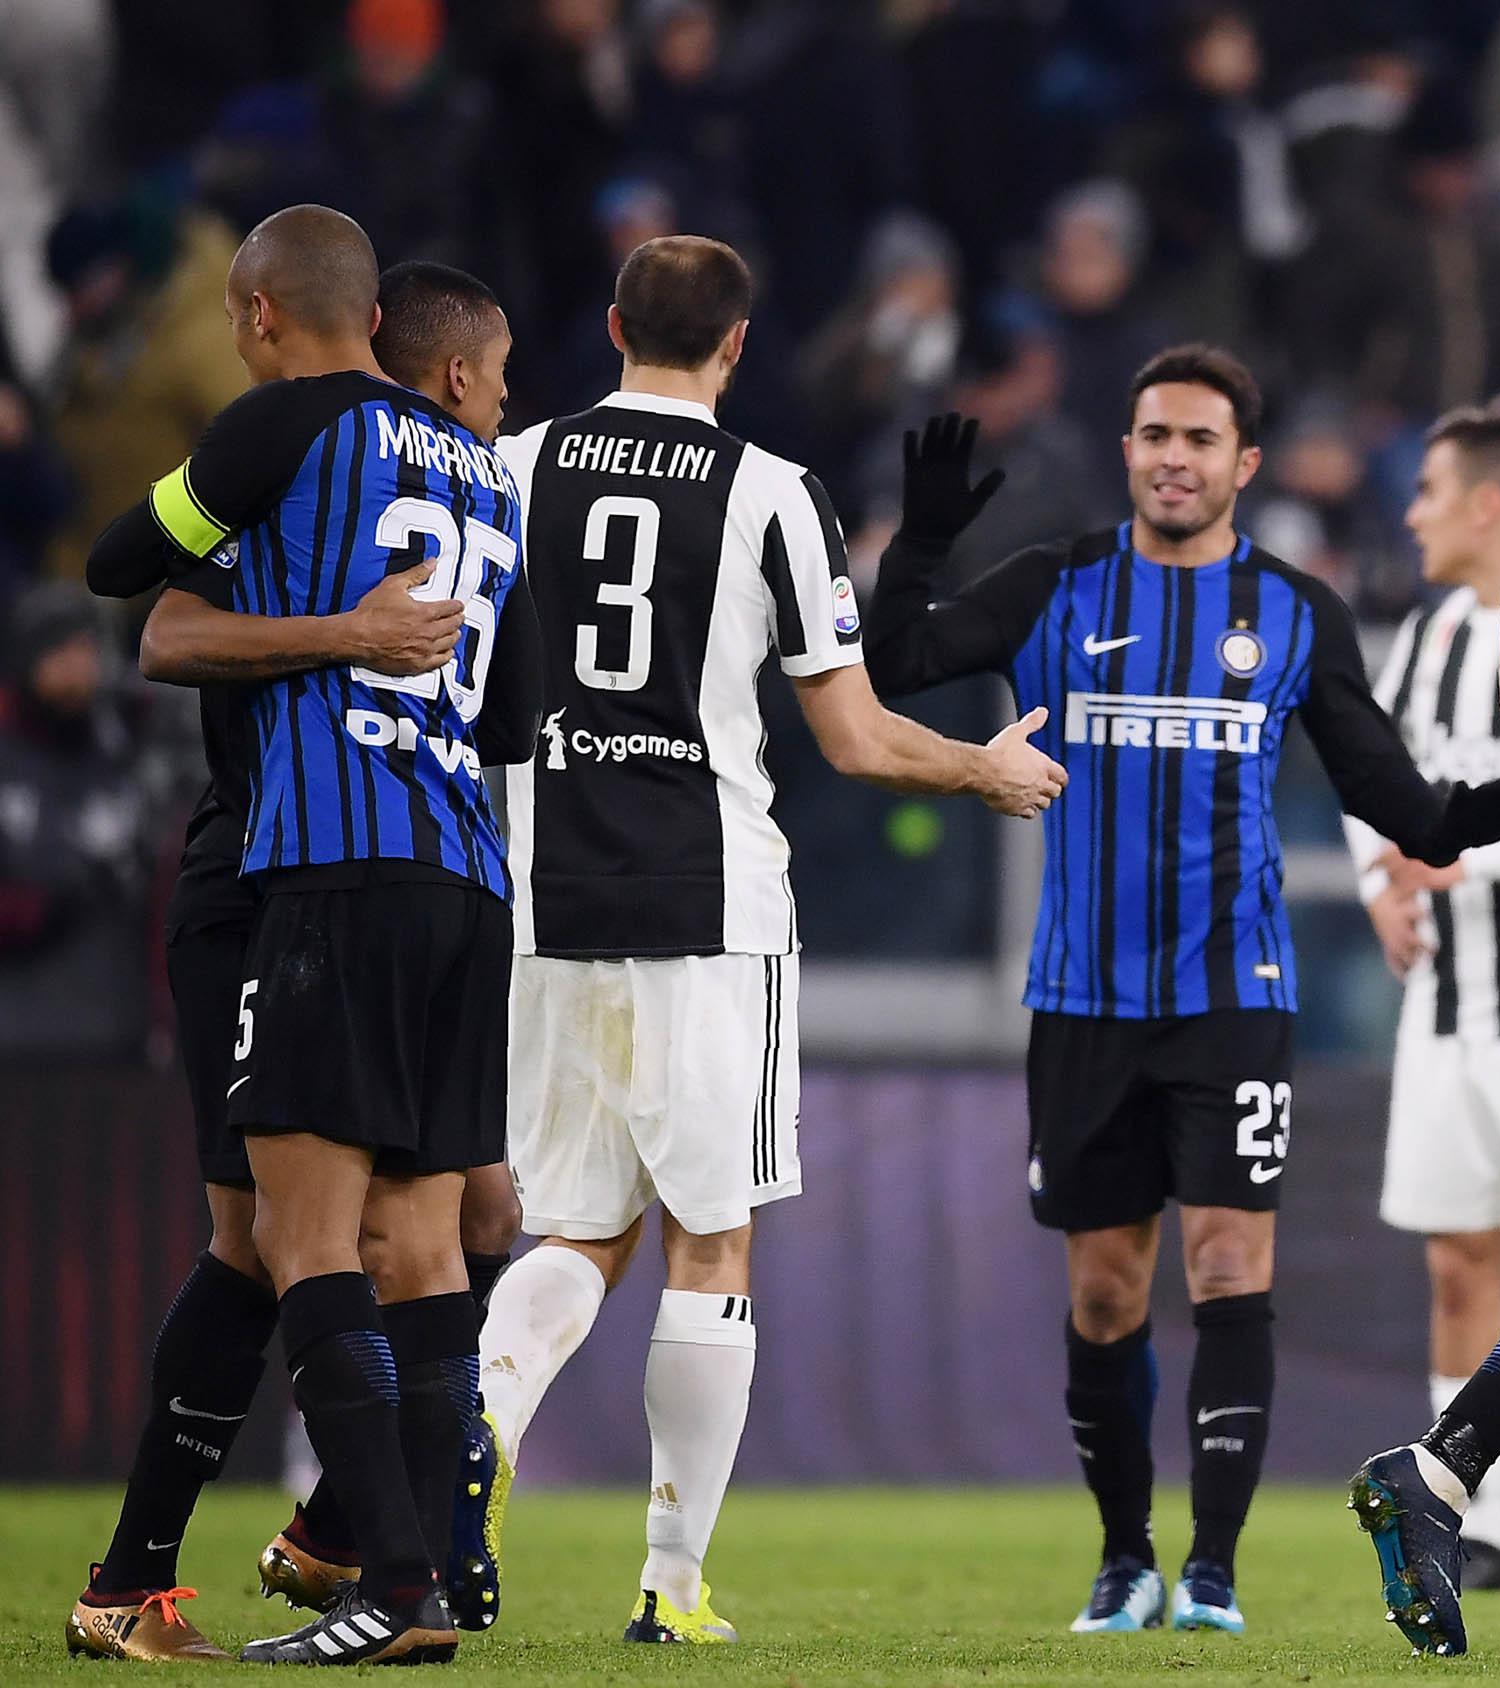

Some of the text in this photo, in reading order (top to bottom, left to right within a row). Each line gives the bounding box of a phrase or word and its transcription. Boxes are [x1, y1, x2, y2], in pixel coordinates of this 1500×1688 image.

[375, 409, 521, 505] MIRANDA
[557, 434, 716, 482] CHIELLINI
[574, 495, 661, 692] 3
[571, 729, 703, 763] Cygames
[1064, 691, 1267, 754] PIRELLI
[234, 978, 259, 1061] 5
[1235, 1080, 1292, 1159] 23
[175, 1432, 222, 1461] INTER
